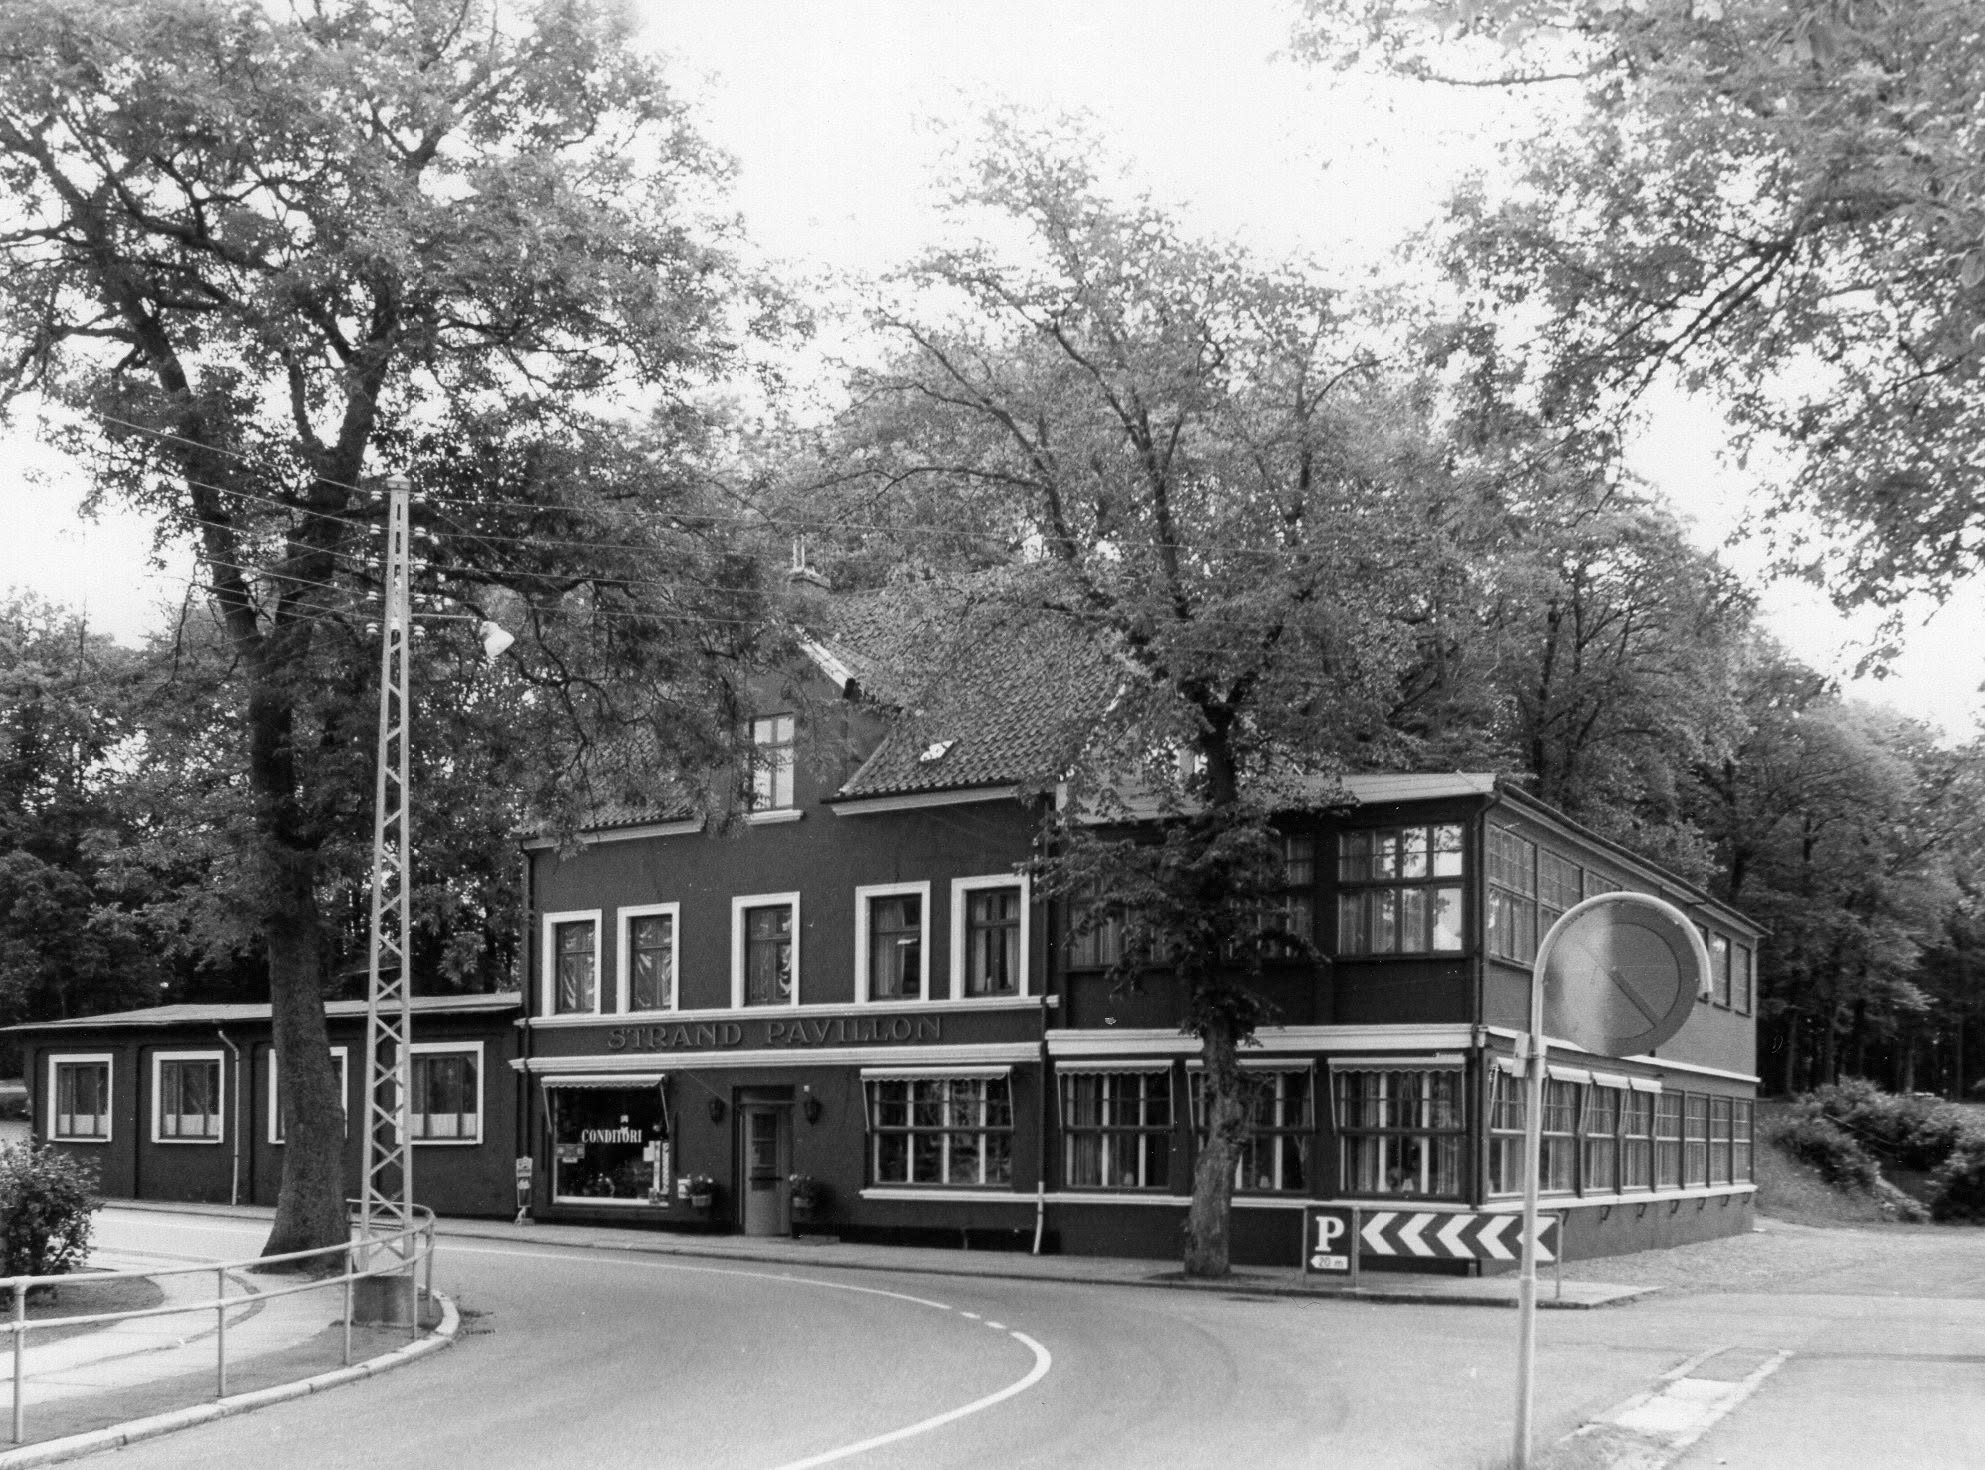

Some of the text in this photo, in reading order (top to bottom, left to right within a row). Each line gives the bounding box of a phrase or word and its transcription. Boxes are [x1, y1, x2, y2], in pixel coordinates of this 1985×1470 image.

[608, 1016, 943, 1049] STRAND PAVILLON
[581, 1129, 642, 1143] CONDITORI
[1315, 1215, 1345, 1252] P
